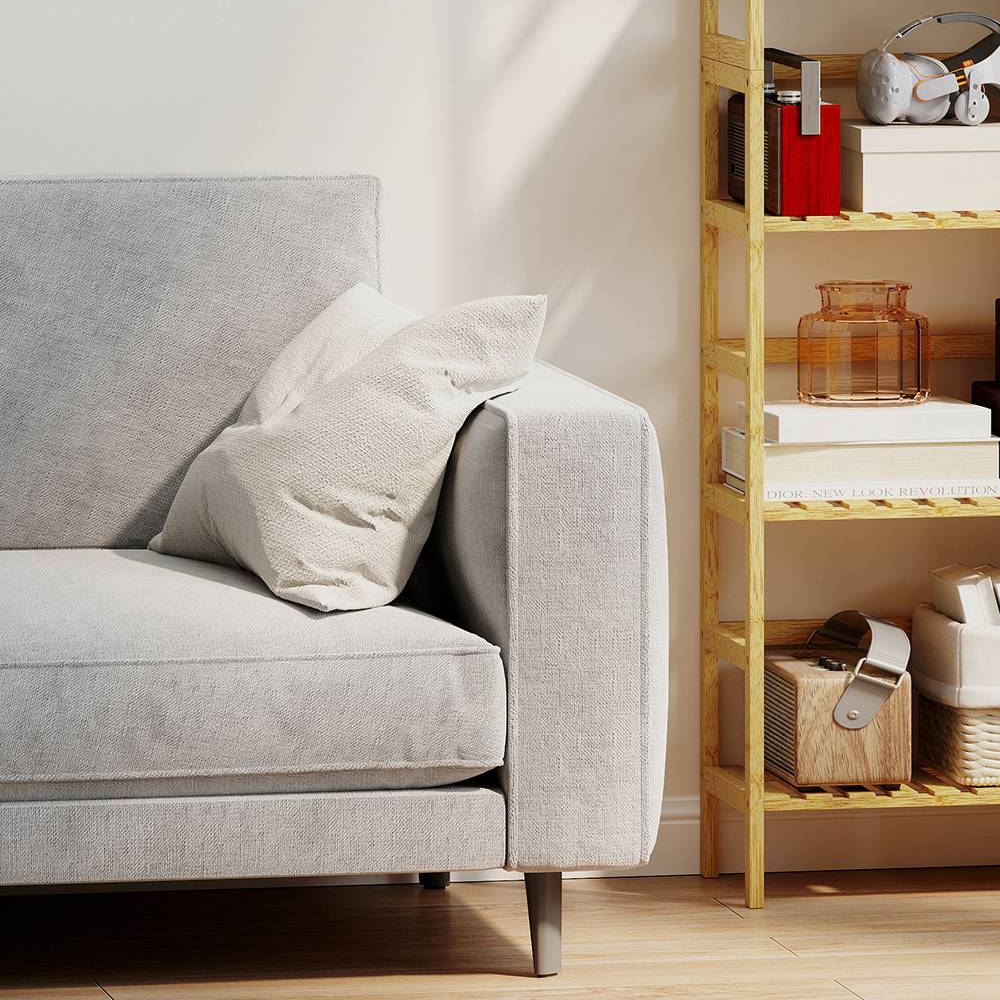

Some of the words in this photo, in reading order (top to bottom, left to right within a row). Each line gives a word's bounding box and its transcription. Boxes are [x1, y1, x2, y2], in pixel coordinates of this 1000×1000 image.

[812, 488, 847, 499] NEW
[852, 486, 895, 498] LOOK
[899, 485, 999, 497] REVOLUTION
